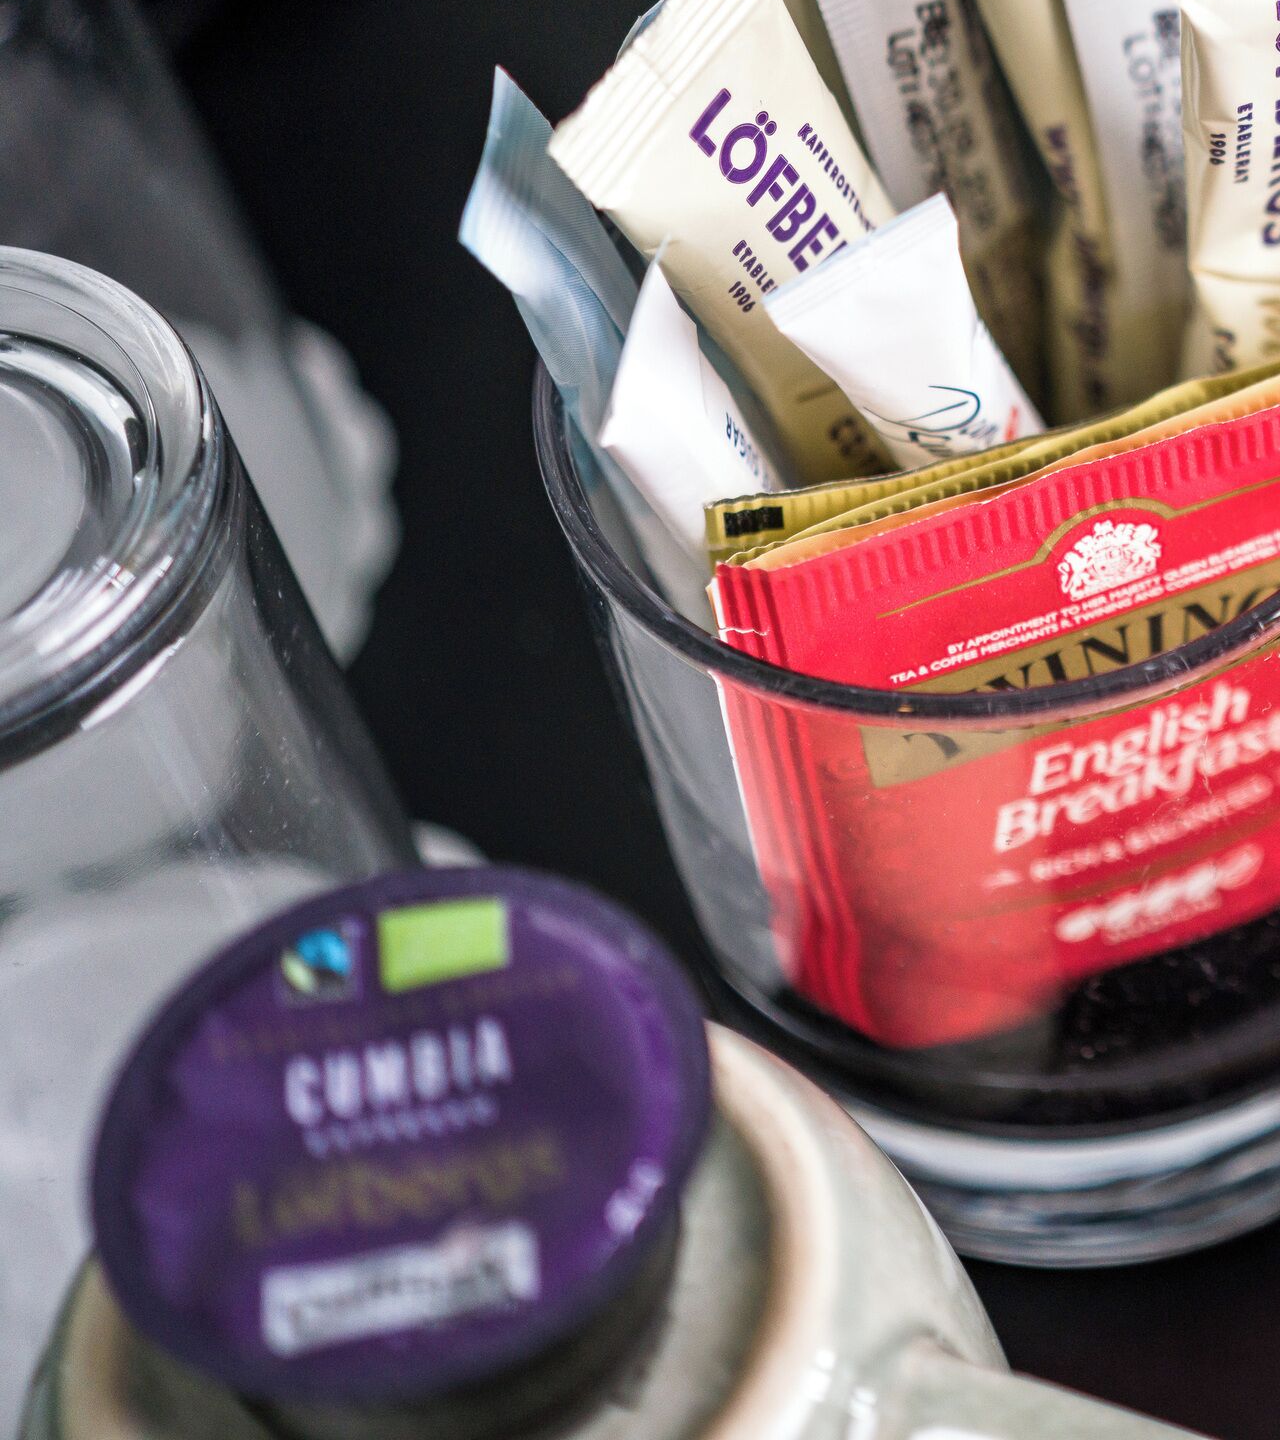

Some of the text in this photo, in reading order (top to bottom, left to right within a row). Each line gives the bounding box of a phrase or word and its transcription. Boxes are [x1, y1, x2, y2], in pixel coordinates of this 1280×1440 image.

[689, 88, 848, 274] LÖFBE
[1209, 133, 1227, 166] 1906
[1235, 102, 1254, 183] ETABLERAT
[728, 280, 756, 313] 1906
[732, 239, 779, 295] ETABLE
[889, 669, 917, 684] TEA
[918, 665, 929, 676] &
[930, 649, 979, 672] COFFEE
[980, 622, 1059, 657] MERCHANTS
[1073, 597, 1133, 625] TWINING
[1133, 585, 1165, 603] AND
[946, 640, 965, 656] BY
[966, 611, 1059, 650] APPOINTMENT
[1061, 605, 1081, 618] TO
[1081, 594, 1108, 610] HER
[1108, 575, 1162, 602] MAJESTY
[1029, 680, 1250, 797] English
